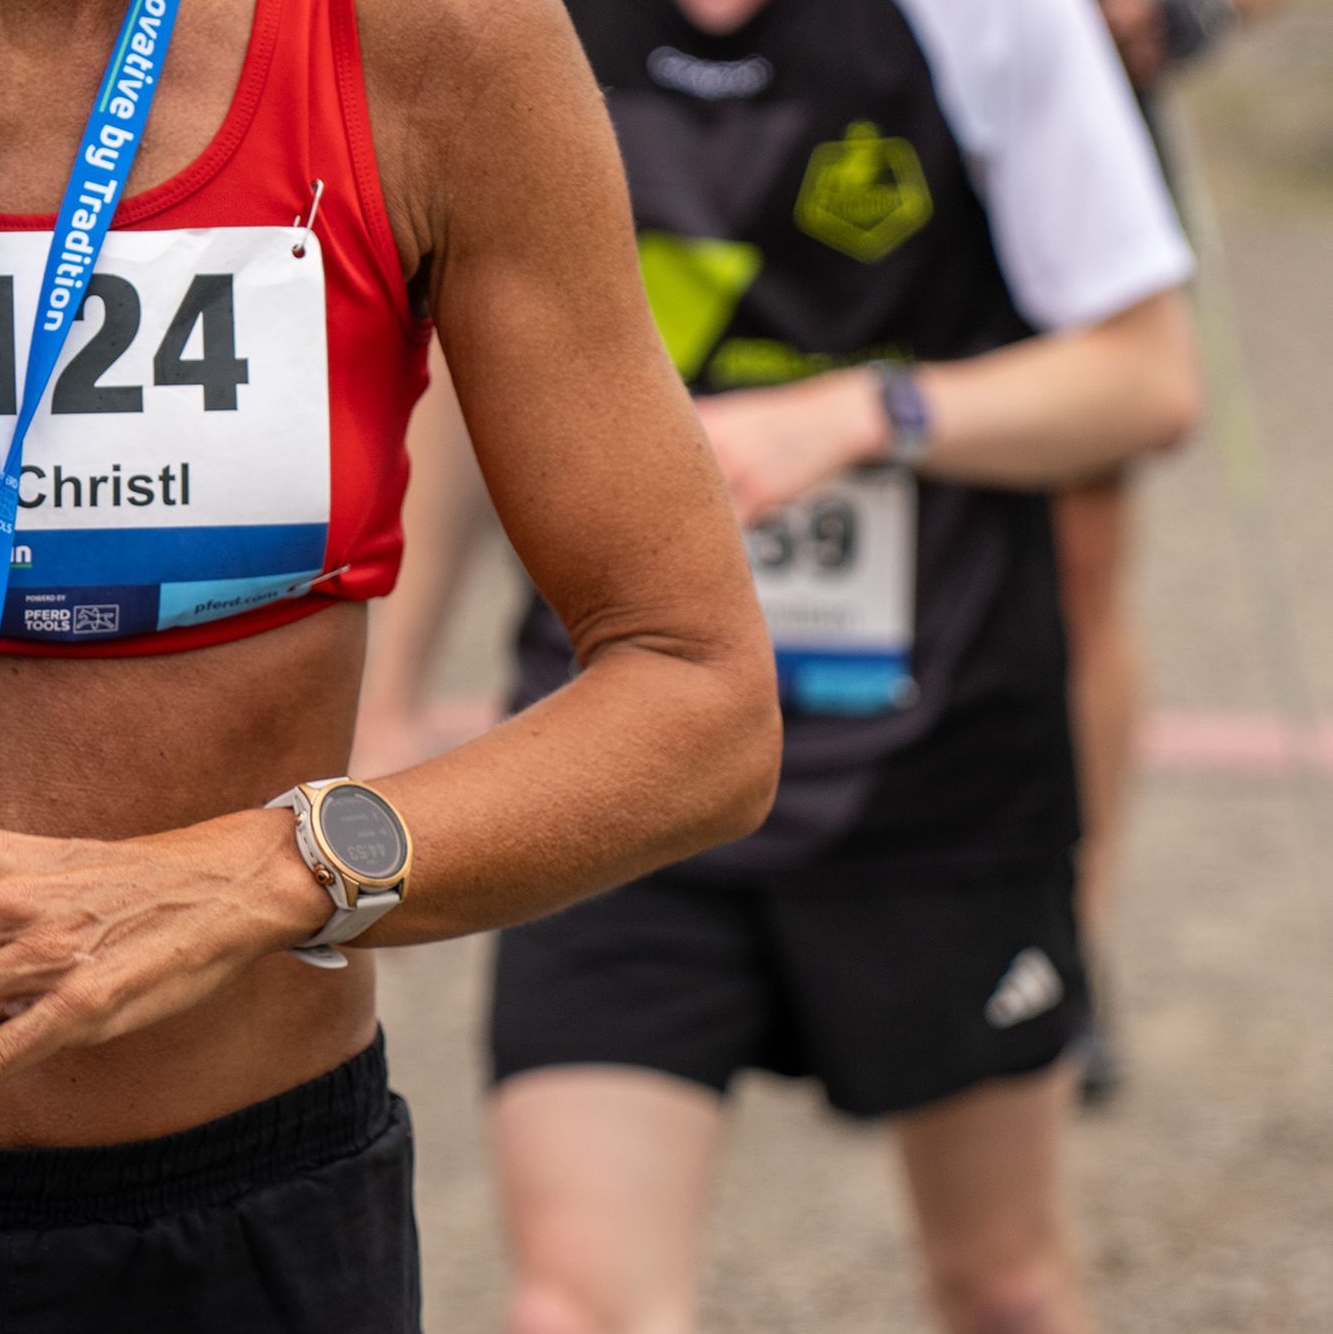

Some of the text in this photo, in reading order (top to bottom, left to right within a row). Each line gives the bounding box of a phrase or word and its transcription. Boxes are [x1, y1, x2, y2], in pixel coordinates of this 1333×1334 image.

[85, 124, 134, 172] by
[43, 178, 118, 332] Tradition
[18, 463, 191, 509] Christl
[24, 609, 71, 620] PFERD
[25, 620, 71, 632] TOOLS
